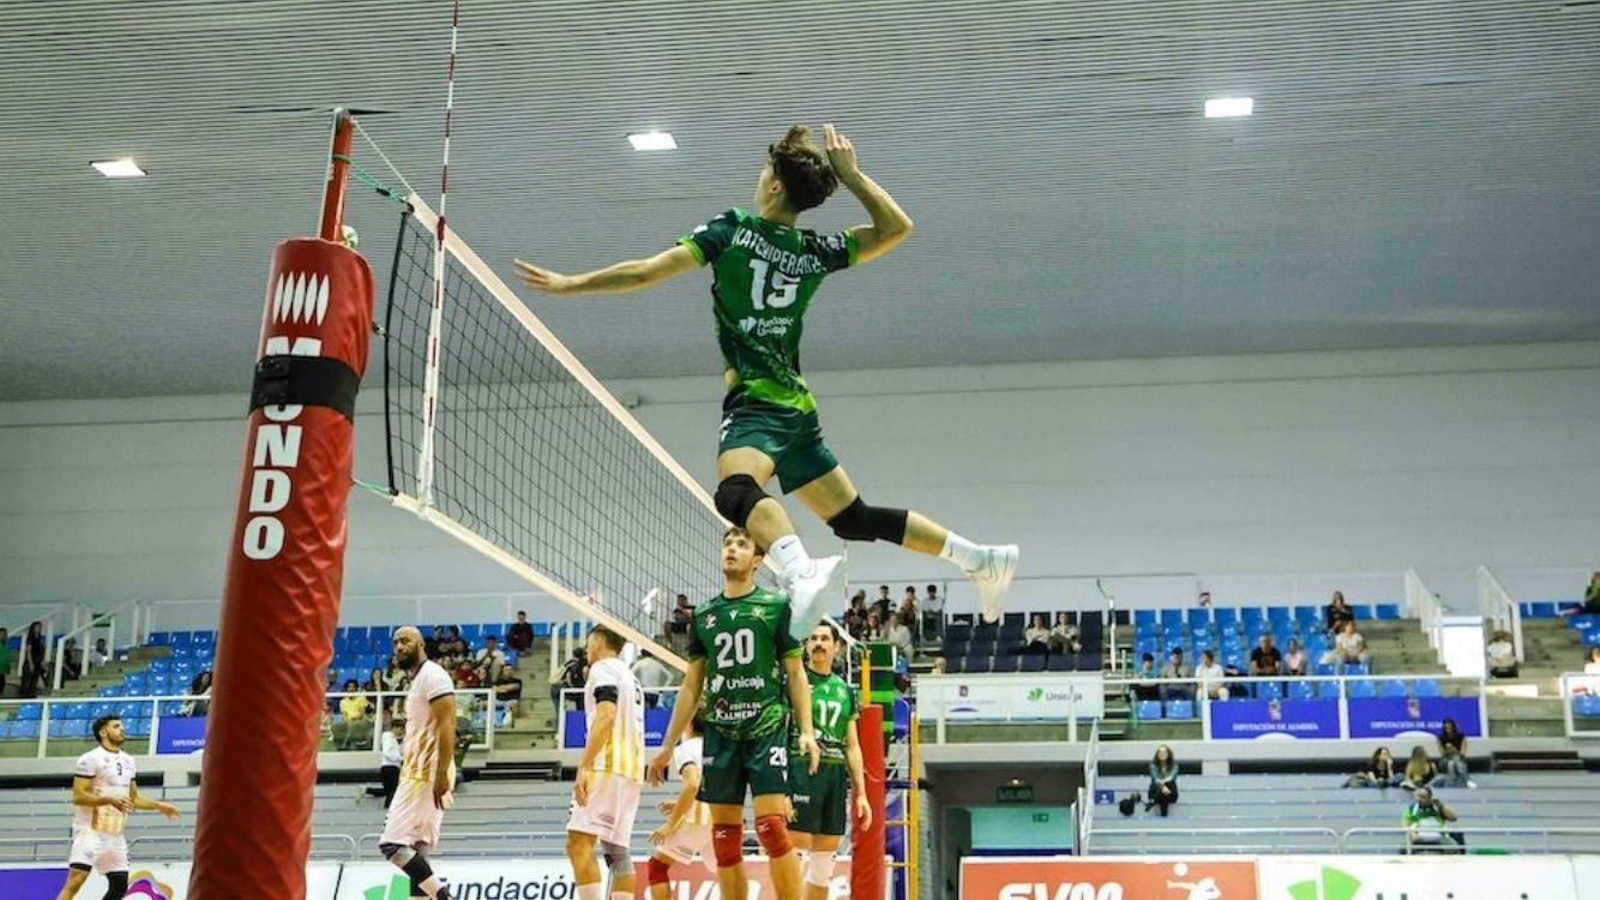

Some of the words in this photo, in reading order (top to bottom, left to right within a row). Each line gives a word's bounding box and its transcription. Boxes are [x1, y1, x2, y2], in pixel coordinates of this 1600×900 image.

[749, 259, 800, 310] 15
[714, 627, 755, 669] 20
[816, 699, 842, 728] 17
[439, 874, 577, 900] undació
